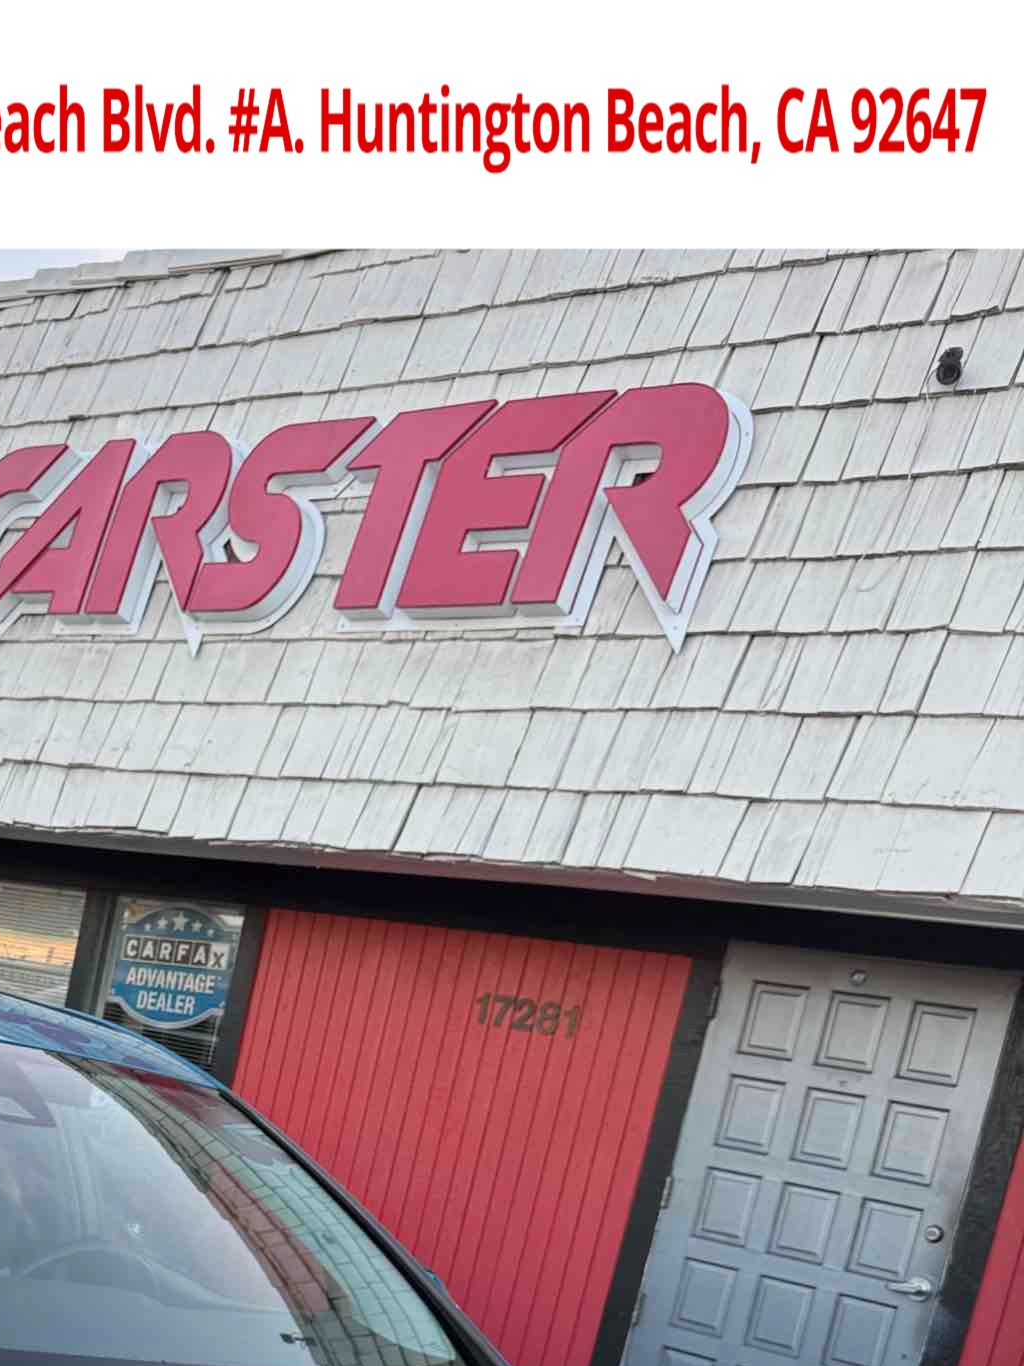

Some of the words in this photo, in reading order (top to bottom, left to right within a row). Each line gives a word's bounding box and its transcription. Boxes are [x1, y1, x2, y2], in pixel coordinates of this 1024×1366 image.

[126, 938, 225, 969] CARFAX
[125, 966, 217, 995] ADVANTAGE
[136, 990, 196, 1016] DEALER
[476, 992, 582, 1039] 17281
